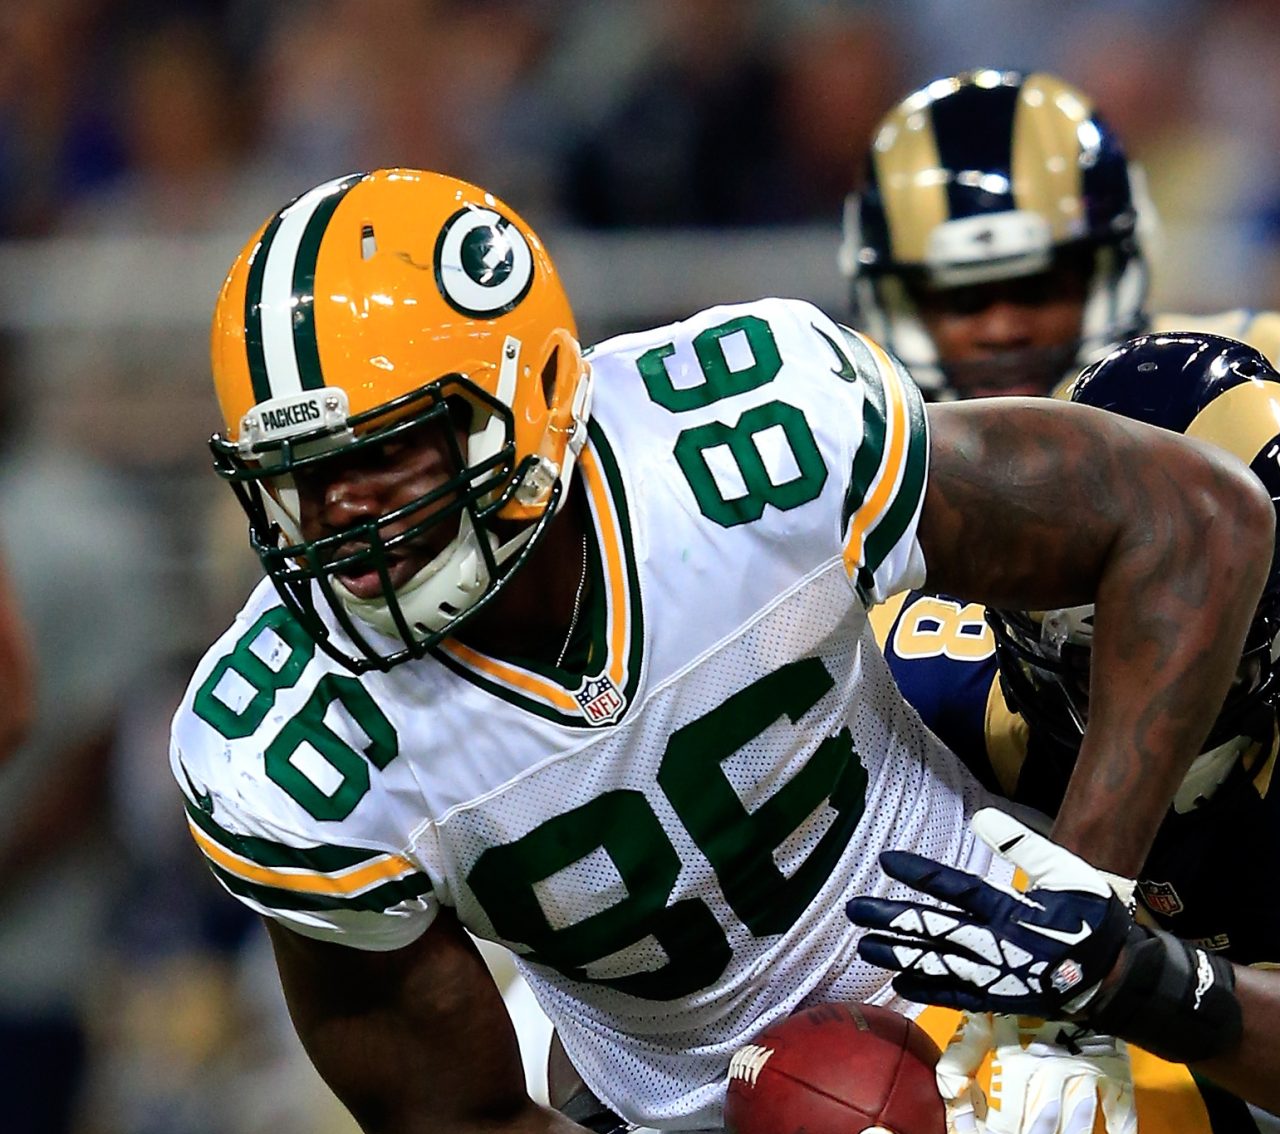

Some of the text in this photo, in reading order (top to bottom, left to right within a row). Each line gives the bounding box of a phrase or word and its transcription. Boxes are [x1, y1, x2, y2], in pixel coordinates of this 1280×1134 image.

[260, 399, 320, 432] PACKERS
[636, 315, 829, 528] 86
[192, 604, 399, 822] 86
[587, 692, 620, 720] NFL
[466, 656, 870, 1001] 86
